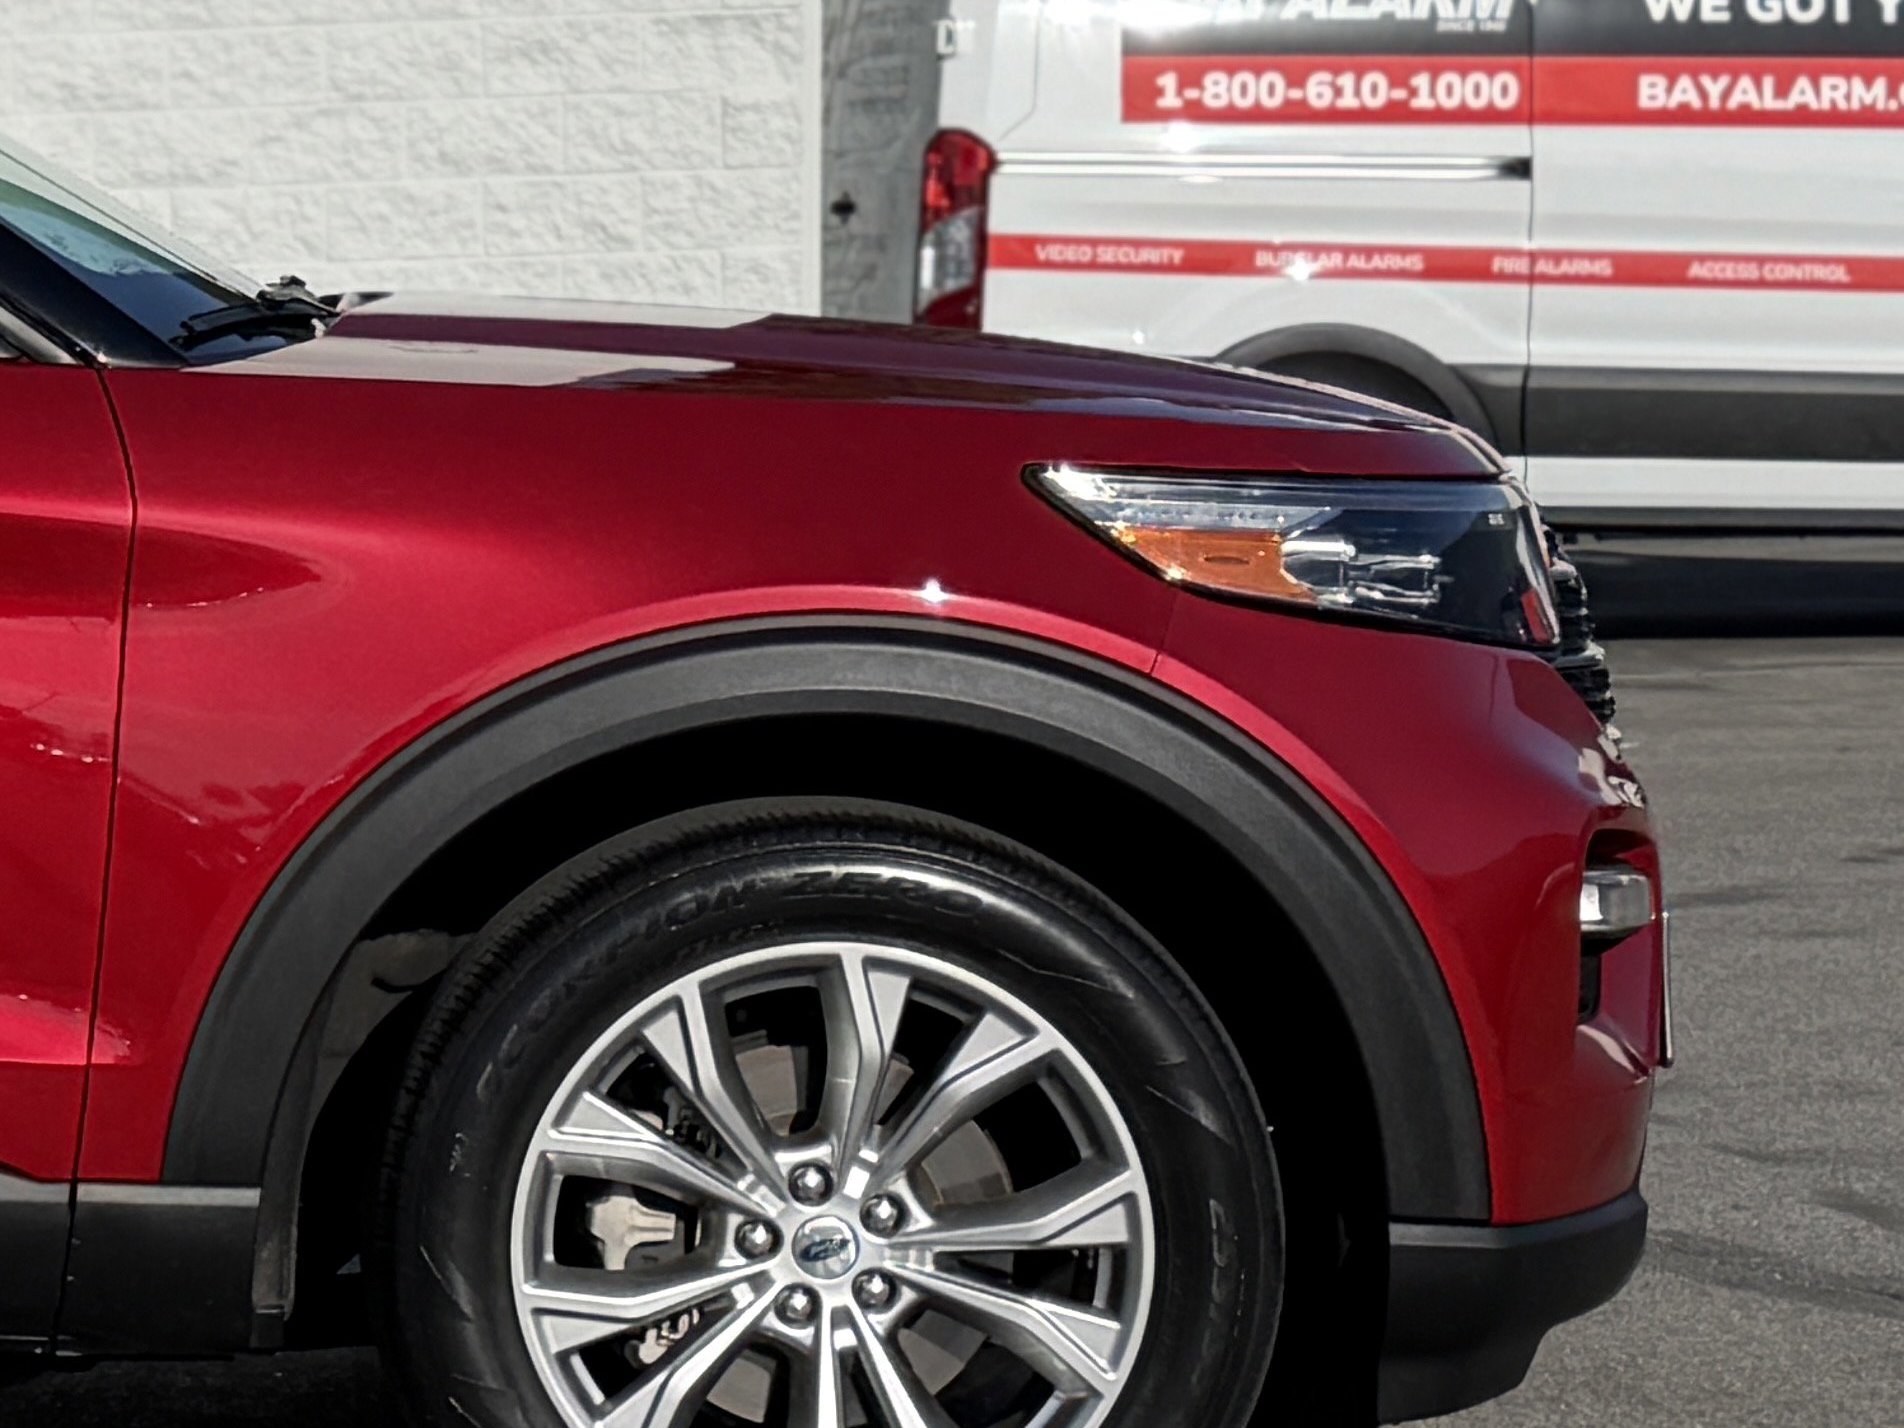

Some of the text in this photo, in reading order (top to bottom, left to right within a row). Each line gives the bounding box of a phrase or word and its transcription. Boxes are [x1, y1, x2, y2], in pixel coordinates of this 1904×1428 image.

[1154, 70, 1521, 110] 1-800-610-1000
[1637, 73, 1904, 111] BAYALARM.
[1034, 243, 1185, 265] VIDEO SECURITY
[1346, 253, 1424, 271] ALARMS
[1492, 256, 1614, 277] FIRE ALARMS
[1687, 259, 1852, 283] ACCESS CONTROL
